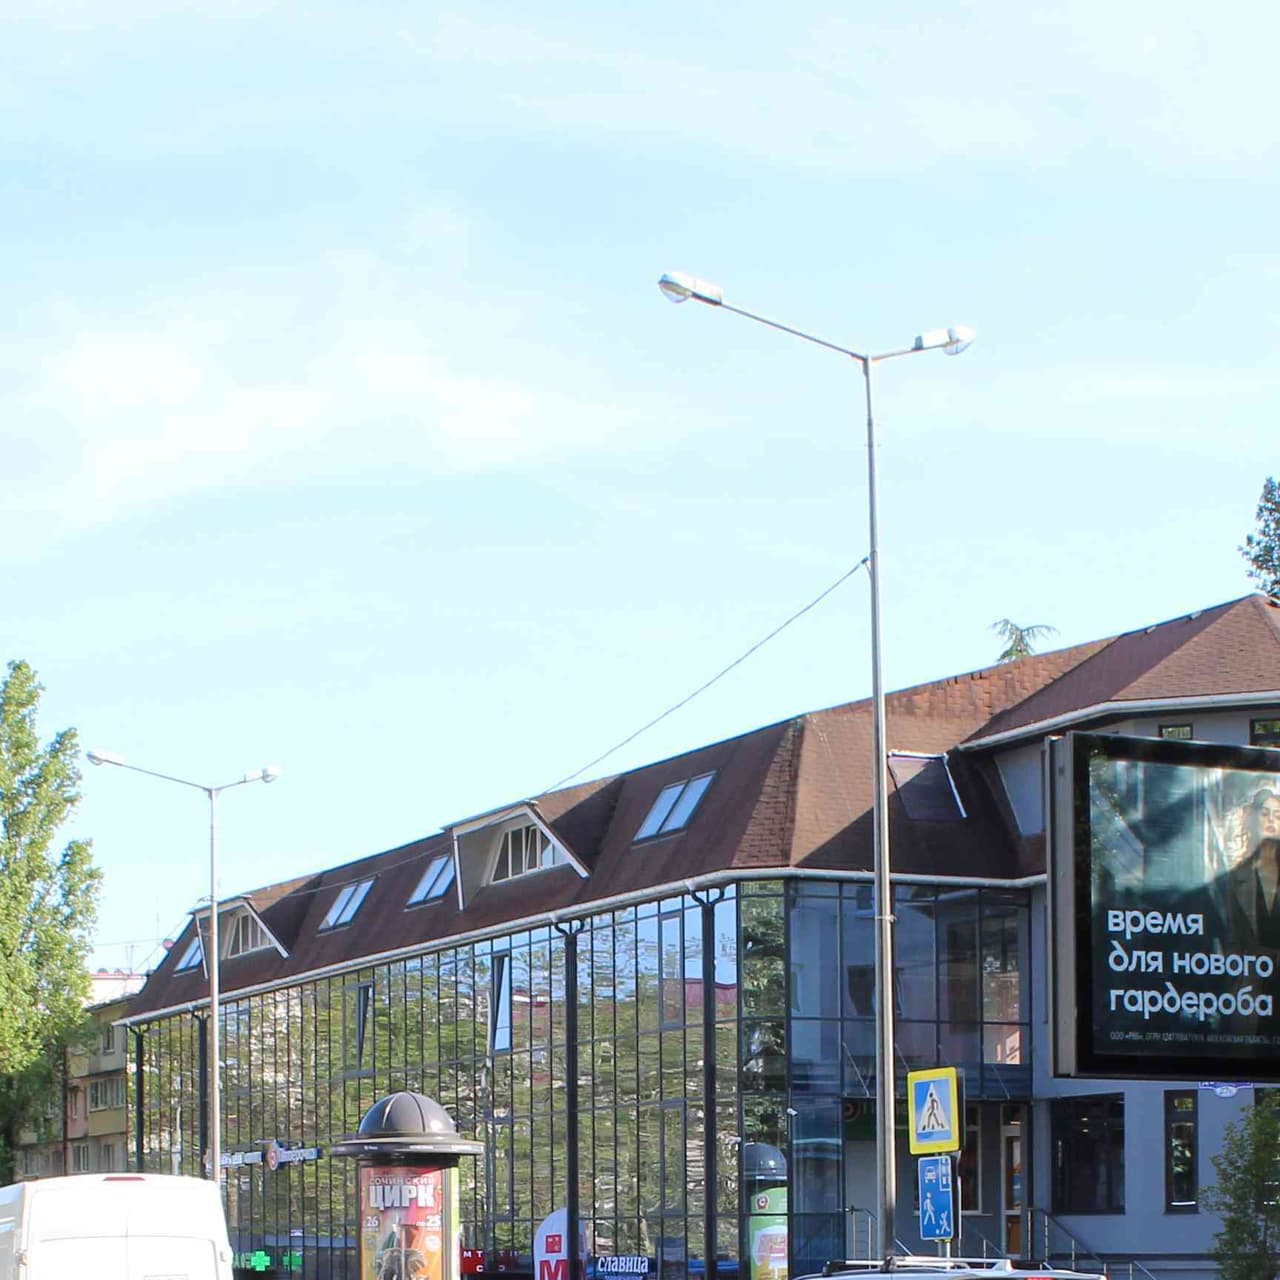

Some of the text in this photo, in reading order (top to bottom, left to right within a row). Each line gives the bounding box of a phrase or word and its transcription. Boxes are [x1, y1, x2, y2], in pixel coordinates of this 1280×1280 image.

[1108, 909, 1204, 939] время
[1108, 940, 1274, 978] для нового
[1109, 981, 1273, 1021] гардероба
[369, 1185, 435, 1211] ЦИРК
